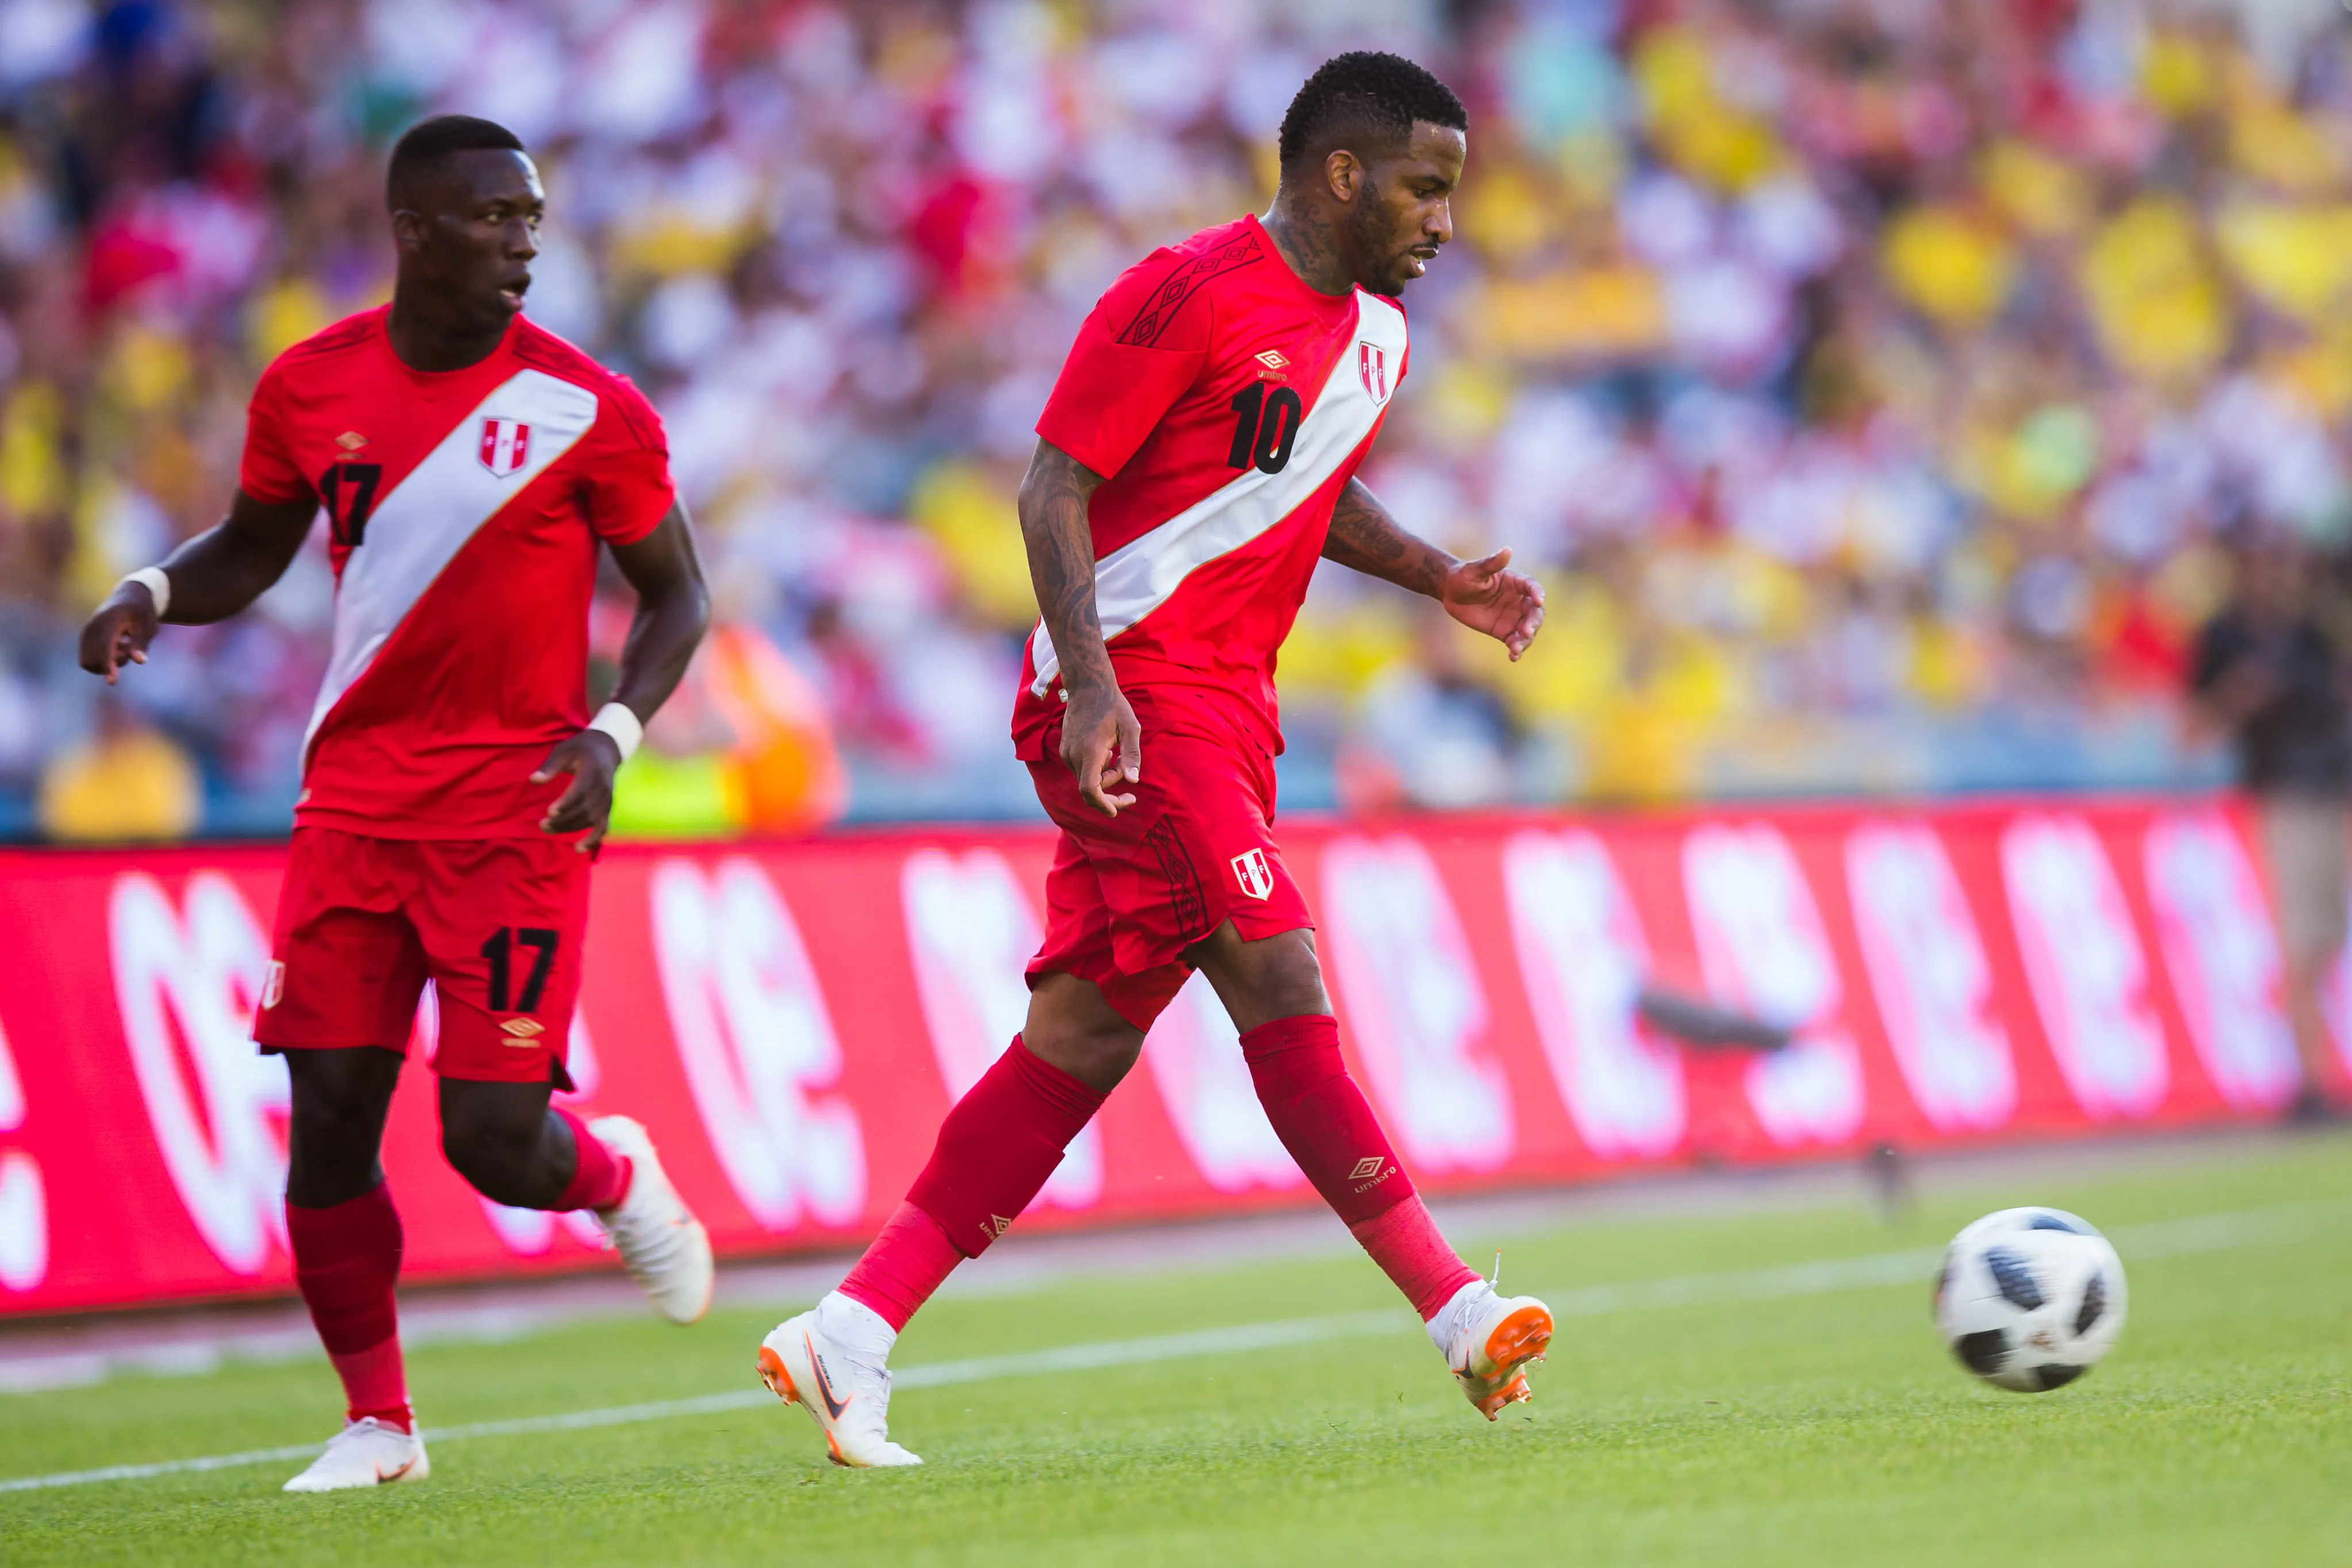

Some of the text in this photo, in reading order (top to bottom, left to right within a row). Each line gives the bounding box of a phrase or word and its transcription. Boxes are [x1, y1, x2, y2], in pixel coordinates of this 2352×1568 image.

[1257, 369, 1288, 382] umbro
[1227, 381, 1302, 475] 10
[319, 462, 382, 547] 17
[481, 926, 560, 1013] 17
[1354, 1166, 1397, 1194] umbro
